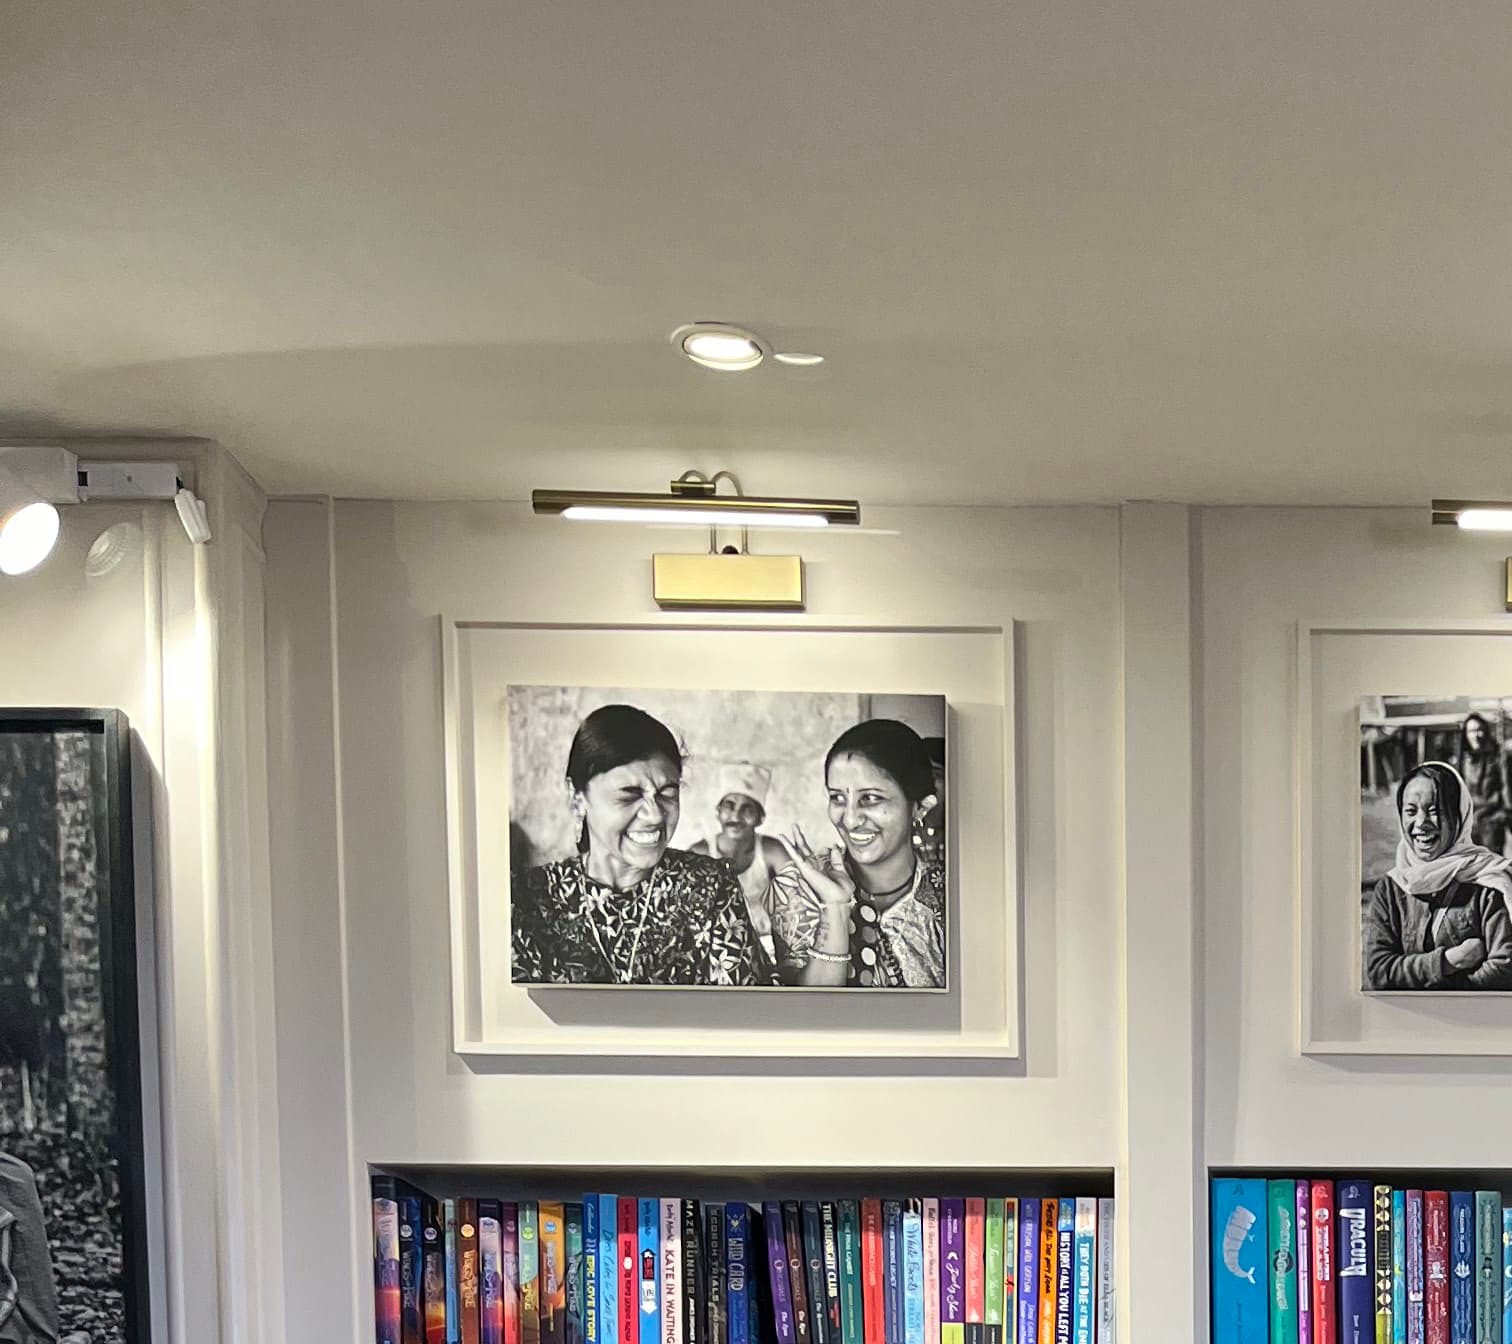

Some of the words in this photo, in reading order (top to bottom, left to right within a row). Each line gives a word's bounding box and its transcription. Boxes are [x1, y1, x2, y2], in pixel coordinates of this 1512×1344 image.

[822, 1204, 832, 1224] THE
[824, 1224, 836, 1270] MIDNIGHT
[1060, 1232, 1071, 1268] HISTORY
[1338, 1208, 1368, 1276] DRACULA
[586, 1280, 596, 1306] LOVE
[828, 1272, 838, 1298] CLUB
[1060, 1274, 1069, 1290] ALL
[1059, 1292, 1070, 1312] YOU
[586, 1310, 596, 1342] STORY
[1058, 1314, 1069, 1336] LEFT
